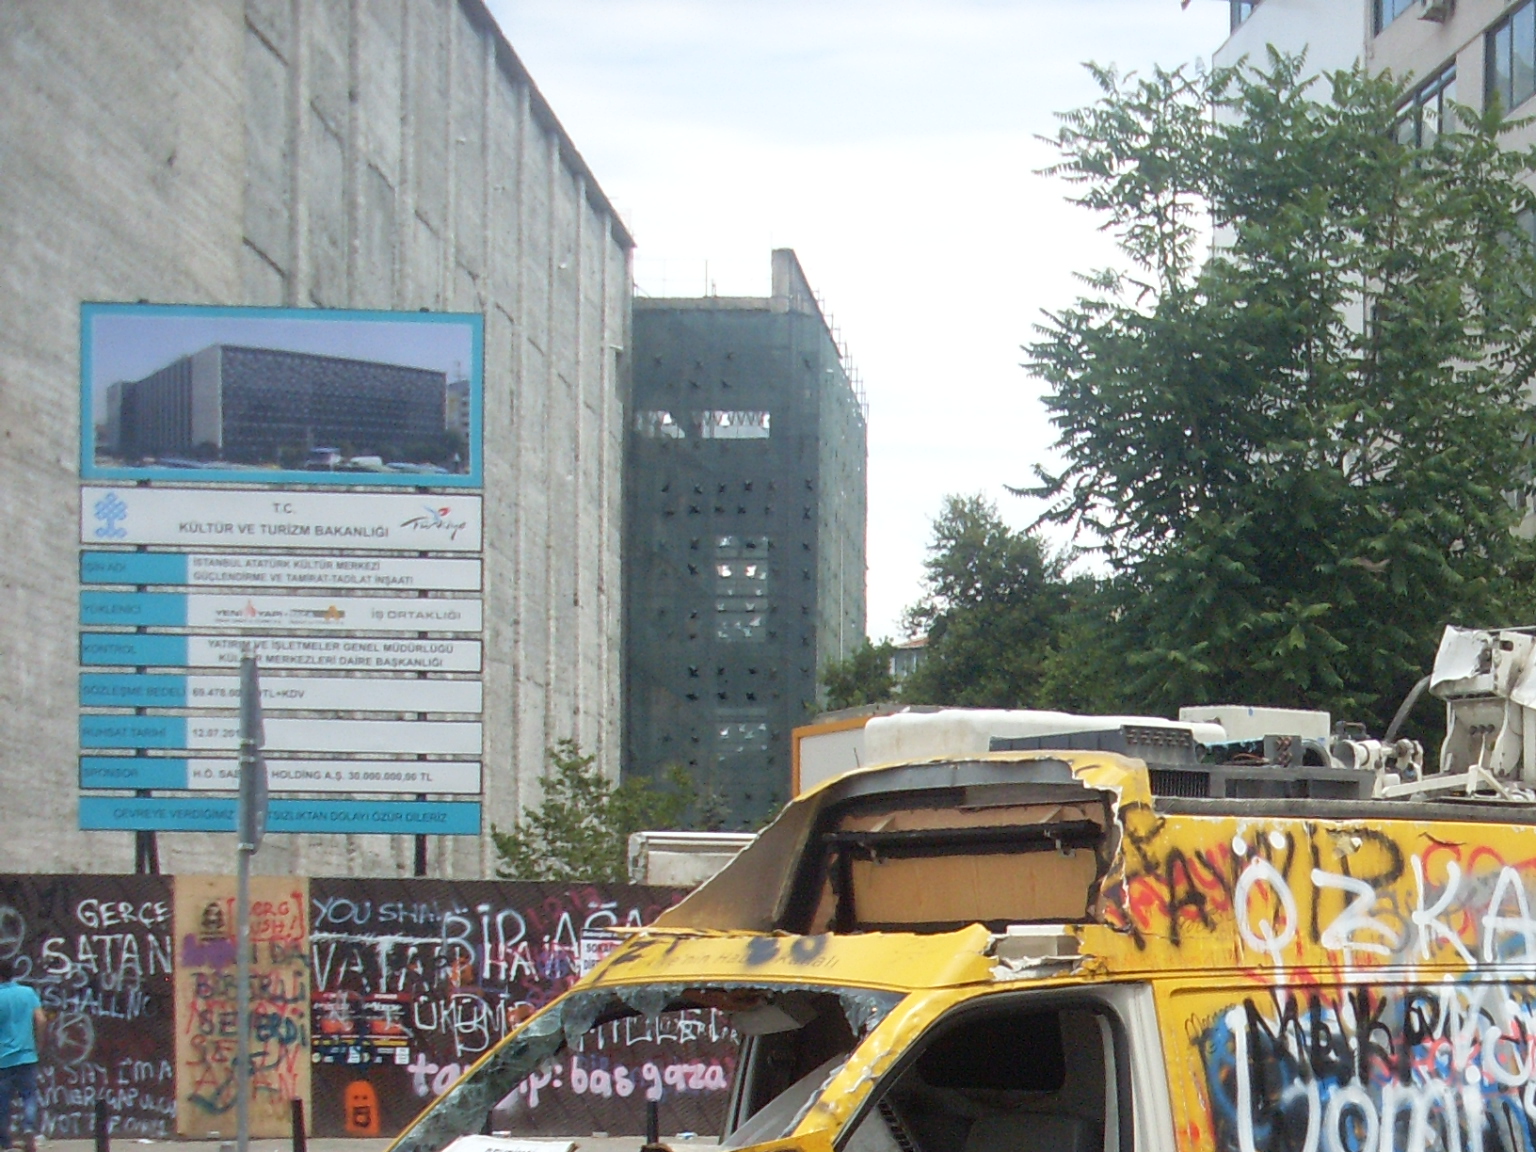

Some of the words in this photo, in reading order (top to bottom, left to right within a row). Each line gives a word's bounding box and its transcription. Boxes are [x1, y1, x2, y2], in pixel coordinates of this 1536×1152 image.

[179, 521, 234, 535] KÜLTÜR
[237, 522, 256, 535] VE
[260, 522, 310, 536] TURİZM
[314, 523, 389, 538] BAKANLIĞI
[193, 558, 243, 569] İSTANBUL
[245, 558, 291, 570] ATATÜRK
[293, 559, 334, 570] KÜLTÜR
[336, 560, 381, 571] MERKEZİ
[193, 571, 267, 583] GÜÇLENDİRME
[270, 572, 284, 582] VE
[371, 610, 383, 621] İŞ
[386, 610, 462, 621] ORTAKLIĞI
[253, 641, 269, 650] VE
[271, 640, 340, 652] İŞLETMELER
[343, 643, 379, 653] GENEL
[383, 642, 454, 654] MÜDÜRLÜĞÜ
[265, 653, 337, 666] MERKEZLERİ
[339, 655, 373, 667] DAİRE
[376, 656, 443, 668] BAŞKANLIĞI
[271, 770, 321, 781] HOLDİNG
[420, 773, 433, 783] TL
[312, 897, 371, 927] YOU
[42, 933, 173, 977] SATAN
[642, 1062, 728, 1103] gaza
